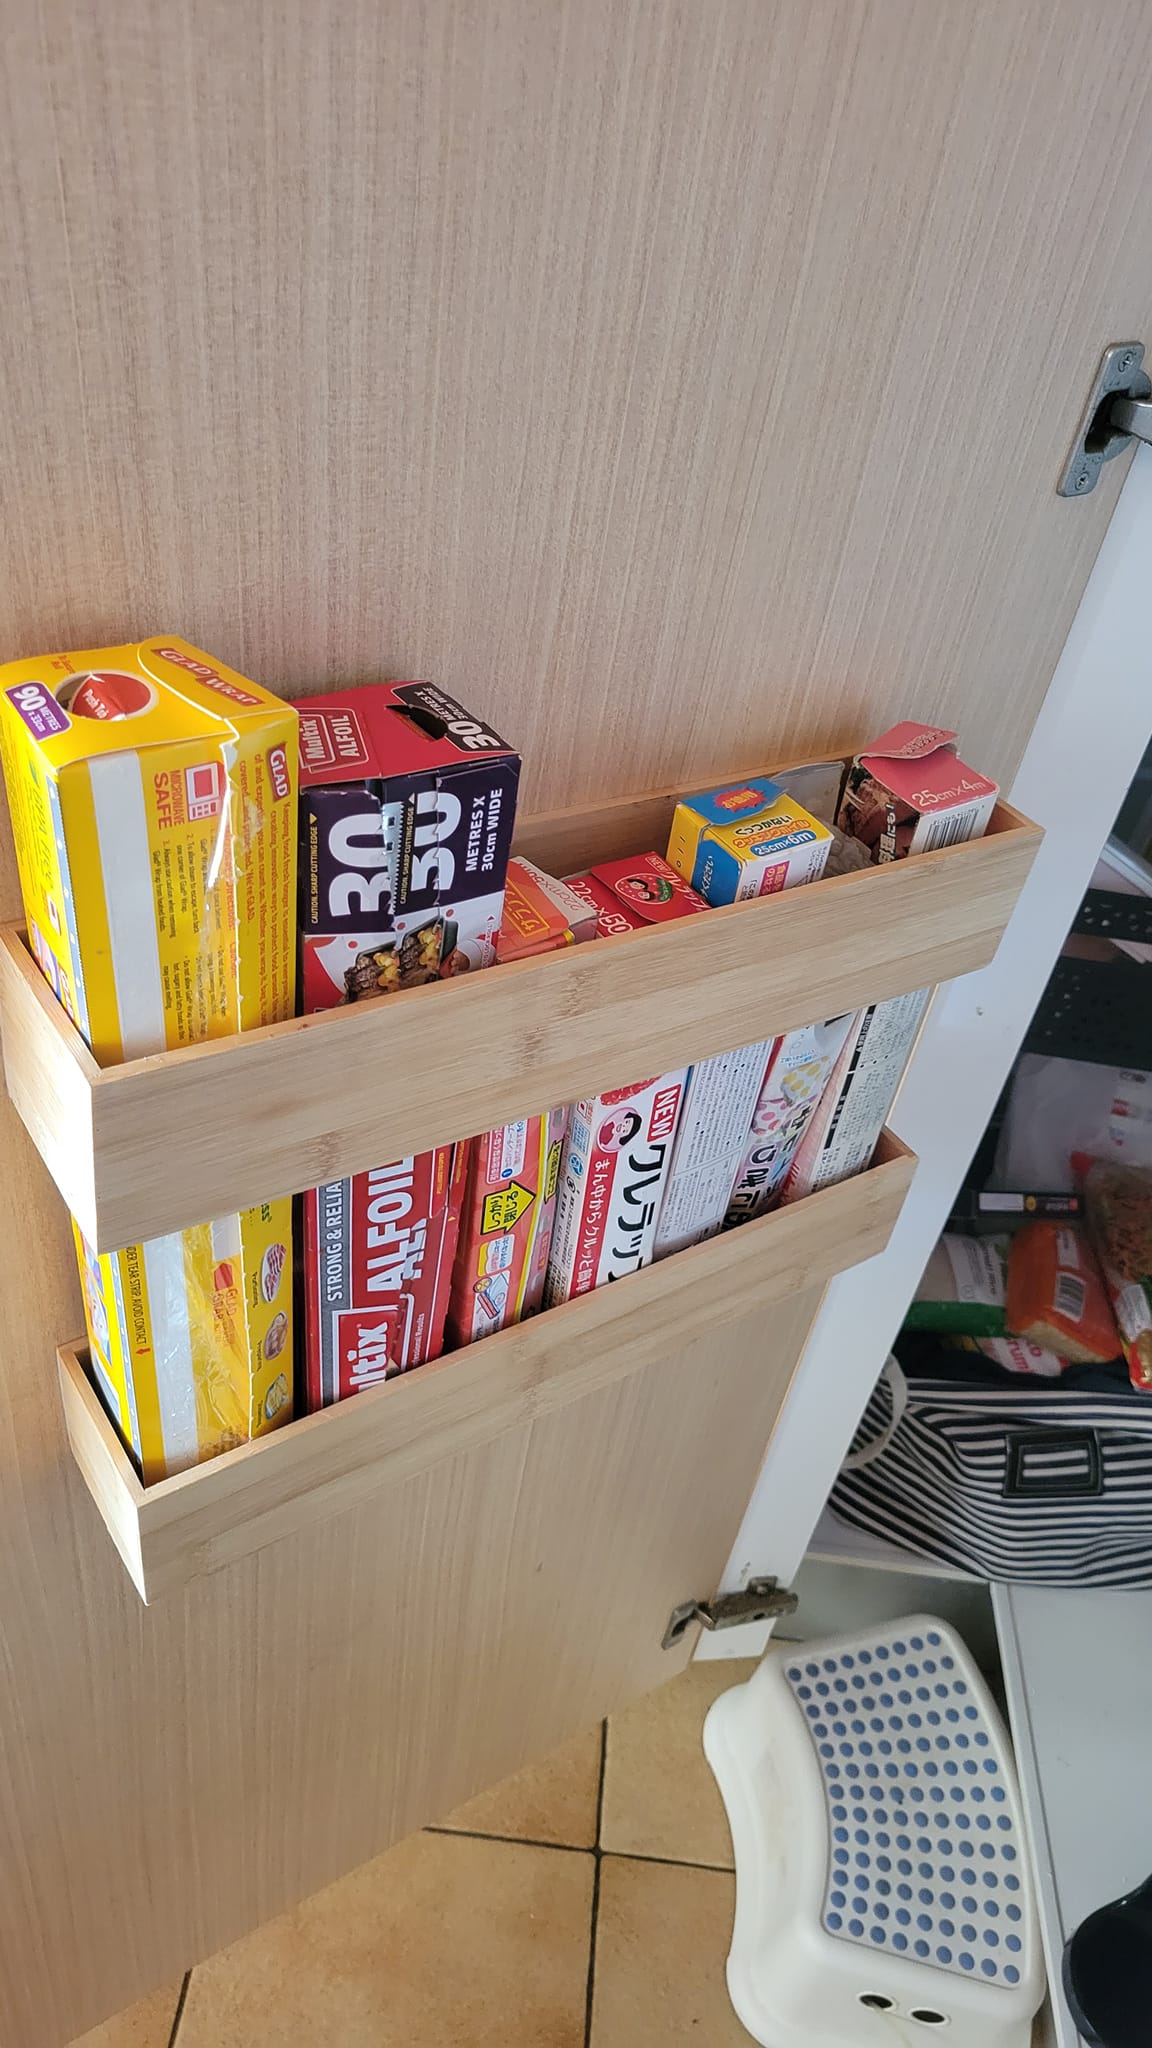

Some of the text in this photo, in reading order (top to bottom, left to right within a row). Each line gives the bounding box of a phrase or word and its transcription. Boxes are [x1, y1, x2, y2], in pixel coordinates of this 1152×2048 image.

[160, 649, 257, 705] GLAD WRAP
[13, 687, 46, 711] 90
[82, 688, 99, 709] Push
[40, 706, 61, 731] METRES
[302, 720, 326, 759] Multix
[331, 715, 360, 757] ALFOIL
[448, 720, 500, 750] 30
[270, 749, 287, 797] GLAD
[154, 772, 172, 830] SAFE
[170, 770, 184, 826] MICROWAVE
[309, 826, 318, 842] EDGE
[404, 826, 414, 853] CUTTING
[465, 796, 486, 872] METRES X
[481, 789, 503, 872] 30cm WIDE
[310, 843, 319, 873] CUTTING
[402, 854, 411, 876] SHARP
[650, 856, 668, 871] NEW
[310, 874, 319, 895] SHARP
[651, 1089, 679, 1137] NEW
[487, 1194, 504, 1228] しっかり
[503, 1190, 520, 1223] 閉じる
[608, 1144, 666, 1280] クレラッ
[327, 1229, 342, 1240] &
[367, 1156, 414, 1292] ALFOIL
[128, 1263, 141, 1279] TEAR
[326, 1243, 343, 1301] STRONG
[132, 1298, 145, 1319] AVOID
[134, 1319, 148, 1345] CONTACT
